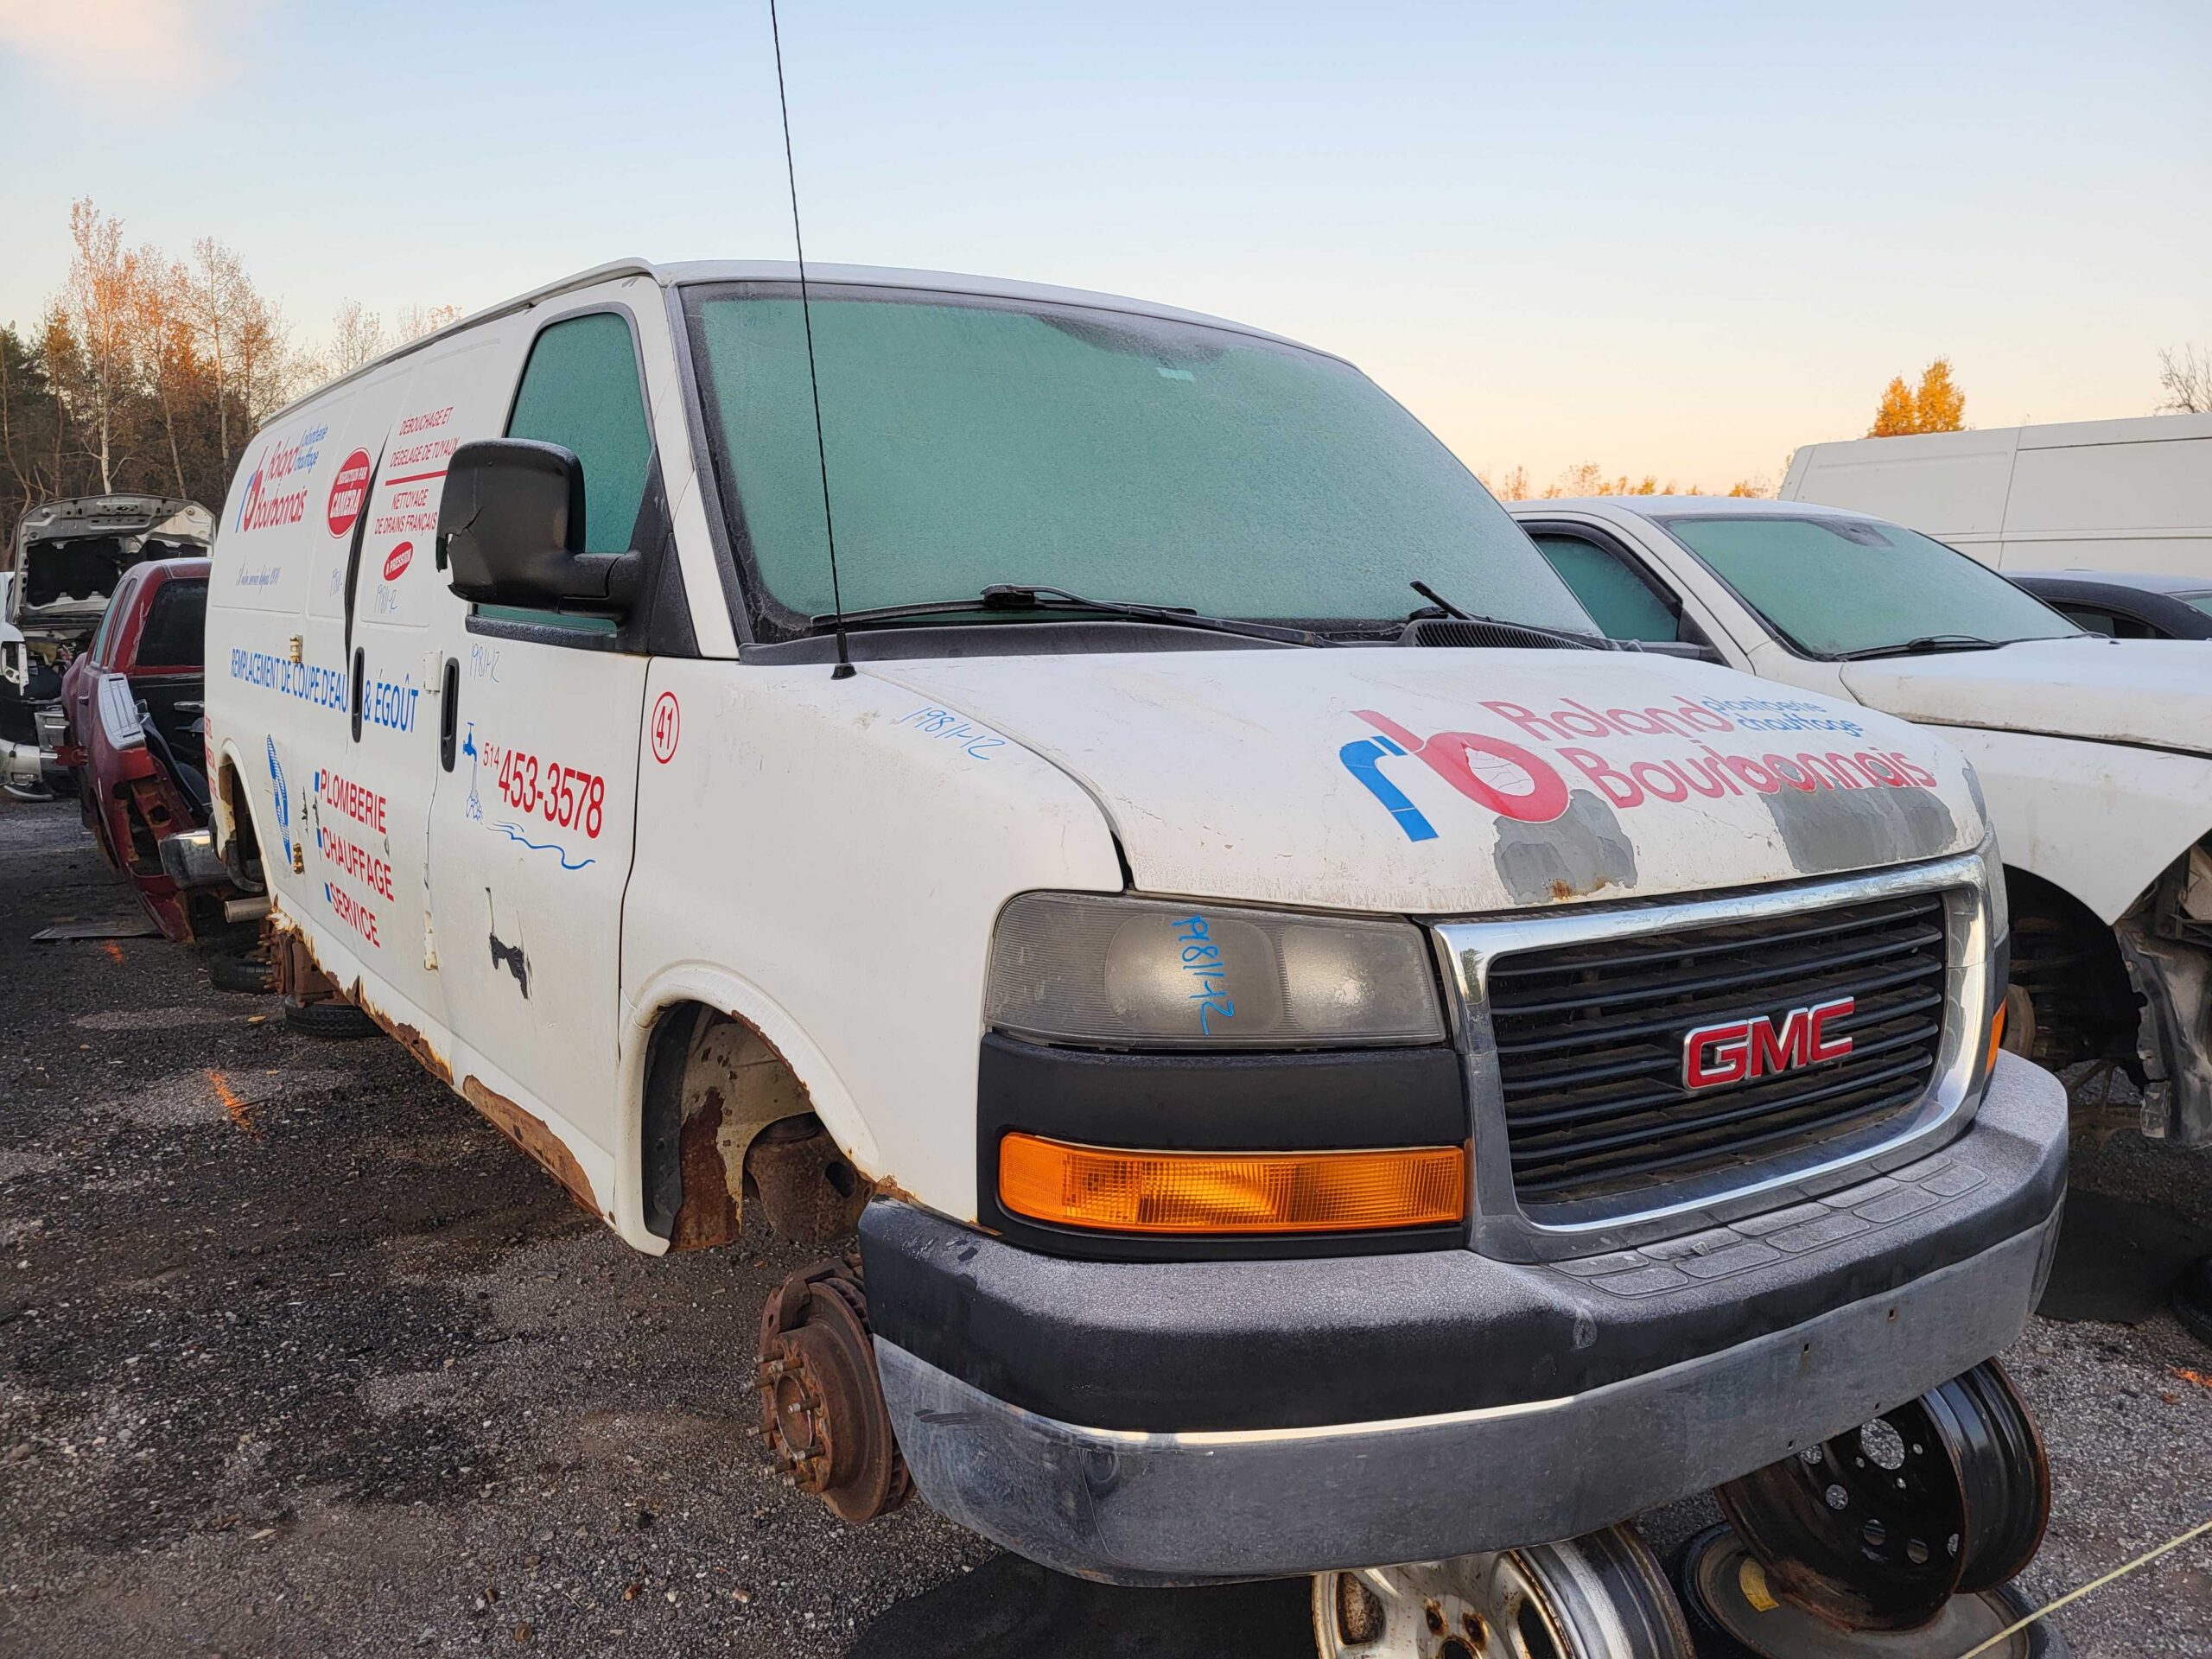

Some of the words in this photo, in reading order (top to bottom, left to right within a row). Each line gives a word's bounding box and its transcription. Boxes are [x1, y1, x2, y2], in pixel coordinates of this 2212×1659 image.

[390, 443, 423, 467] DÉGELAGE
[422, 442, 433, 461] DE
[433, 436, 461, 461] TUYAUX
[399, 409, 444, 435] DÉBOUCHAGE
[442, 406, 454, 424] ET
[374, 518, 384, 535] DE
[383, 515, 405, 534] DRAINS
[404, 512, 438, 536] FRANÇAIS
[391, 489, 429, 510] NETTOYAGE
[231, 648, 280, 690] REMPLACEMENT
[281, 659, 291, 694] DE
[293, 663, 321, 703] COUPE
[321, 668, 348, 713] D'EAU
[363, 679, 372, 721] &
[374, 669, 419, 733] ÉGOÛT
[1478, 696, 1734, 741] Roland
[1701, 695, 1827, 716] plomberie
[656, 705, 673, 750] 41
[320, 768, 387, 835] PLOMBERIE
[483, 742, 500, 771] 514
[498, 749, 605, 839] 453-3578
[1556, 740, 1937, 809] Bourbonnais
[322, 826, 395, 902] CHAUFFAGE
[329, 881, 381, 949] SERVICE
[1682, 996, 1854, 1090] GMC
